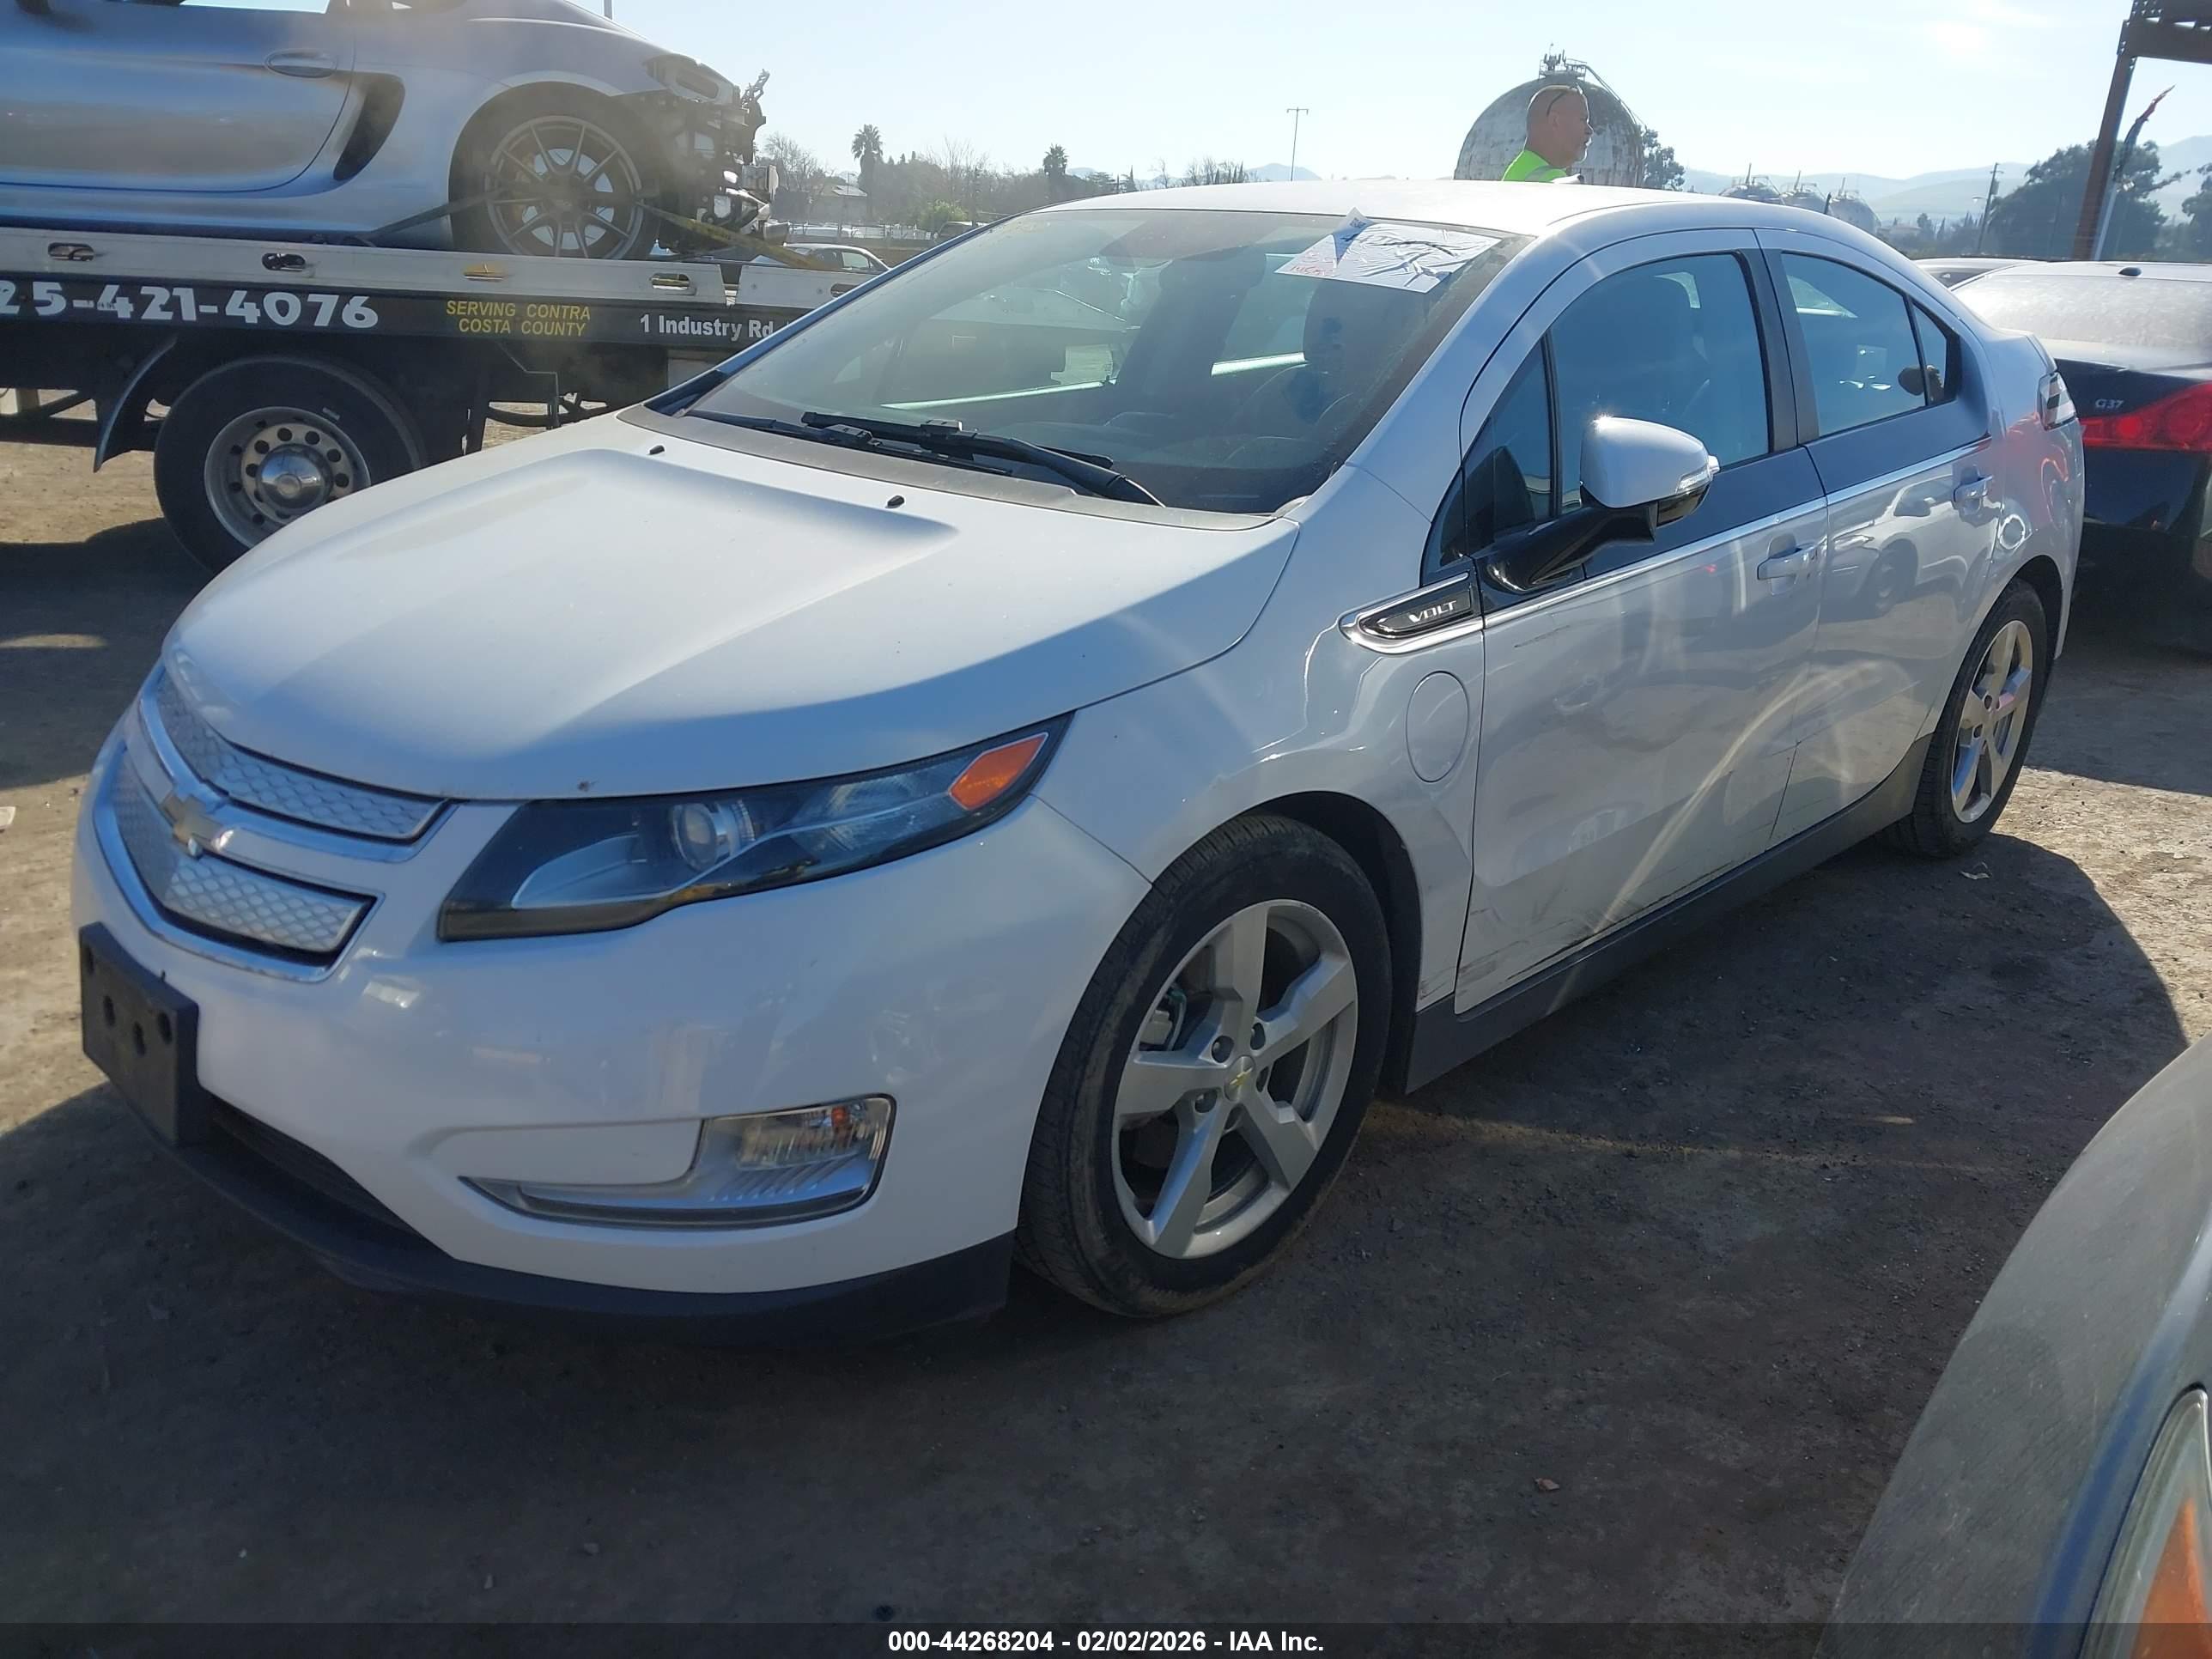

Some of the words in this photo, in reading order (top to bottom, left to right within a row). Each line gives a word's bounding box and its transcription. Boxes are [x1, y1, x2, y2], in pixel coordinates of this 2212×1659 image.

[0, 280, 379, 329] 25-421-4076
[446, 300, 516, 317] SERVING
[526, 303, 591, 320] CONTRA
[459, 318, 512, 334] COSTA
[521, 320, 586, 337] COUNTY
[640, 313, 651, 333] 1
[659, 315, 743, 342] Industry
[748, 319, 774, 338] Rd
[2095, 398, 2124, 409] G37
[1408, 599, 1457, 623] VOLT
